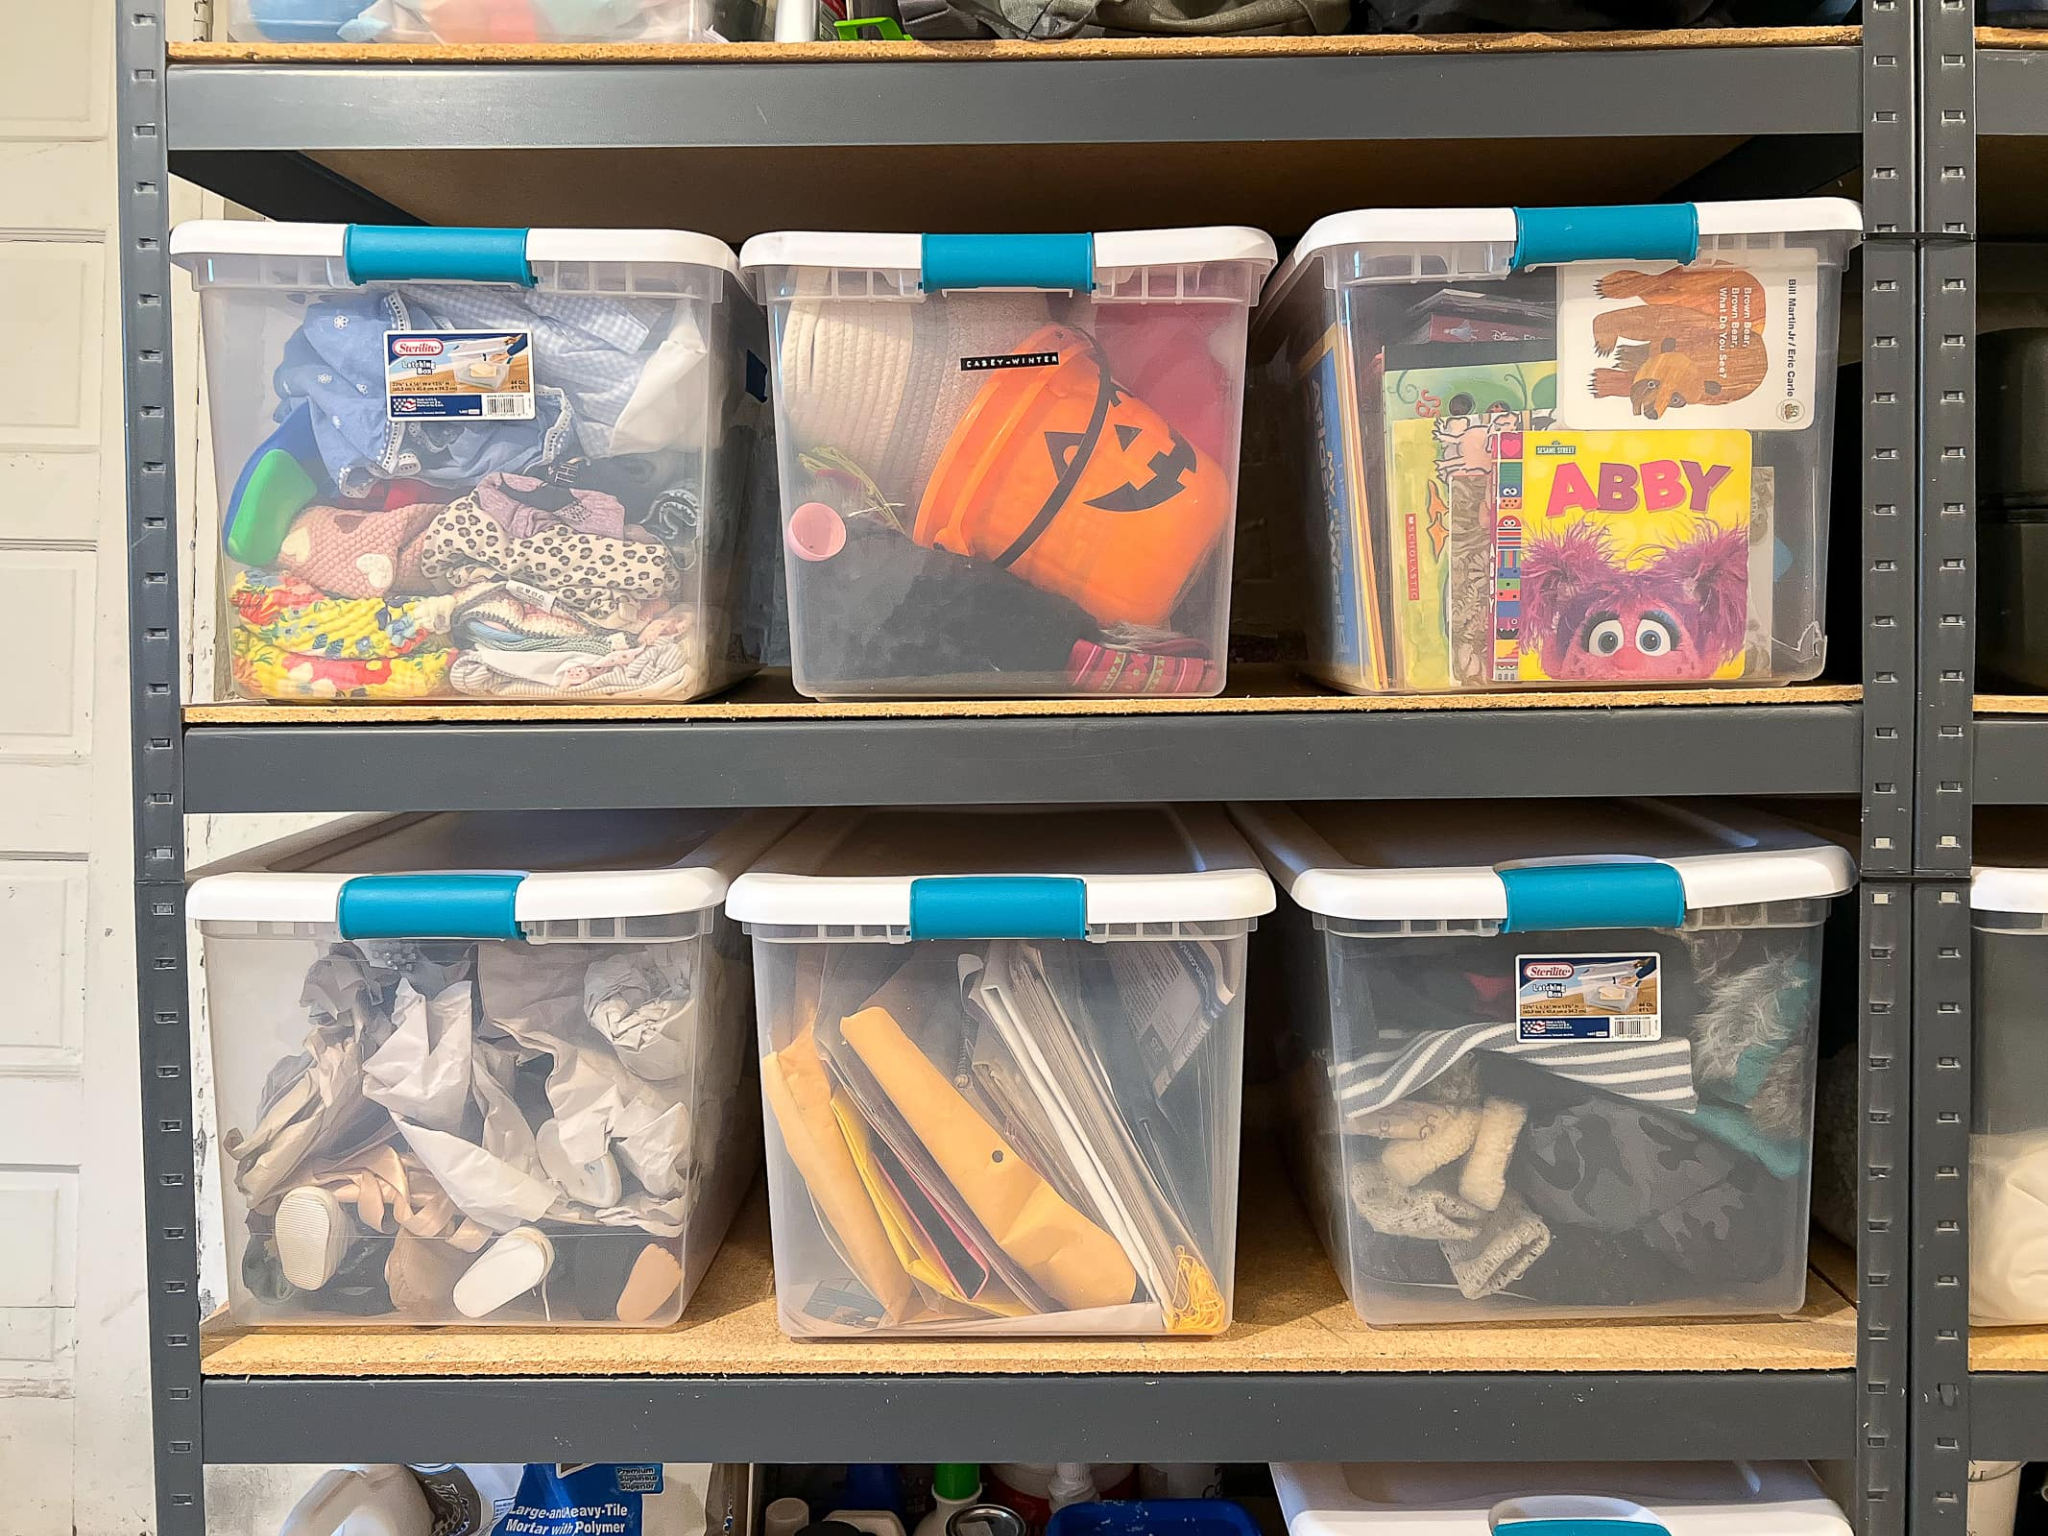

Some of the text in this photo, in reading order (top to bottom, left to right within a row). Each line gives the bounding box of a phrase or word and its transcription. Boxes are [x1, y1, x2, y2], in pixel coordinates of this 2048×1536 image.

[1787, 278, 1797, 295] Bill
[1730, 287, 1740, 348] Brown Bear,
[1742, 287, 1752, 348] Brown Bear,
[1719, 287, 1728, 379] What Do You See?
[399, 342, 437, 353] Sterilite
[402, 360, 436, 370] Latching
[966, 355, 1058, 368] CASEY-WINTER
[1786, 348, 1796, 369] Eric
[417, 368, 433, 376] Box
[1786, 370, 1796, 397] Carle
[1546, 459, 1734, 519] ABBY
[1407, 525, 1418, 600] SCHOLASTIC
[1488, 542, 1496, 614] ABBY
[1328, 520, 1350, 654] World
[1530, 966, 1568, 977] Sterilite
[1532, 983, 1567, 994] Latching
[1547, 991, 1563, 999] Box
[616, 1466, 655, 1476] Premium
[620, 1482, 656, 1492] Superior
[506, 1519, 626, 1536] Mortar with Polymer
